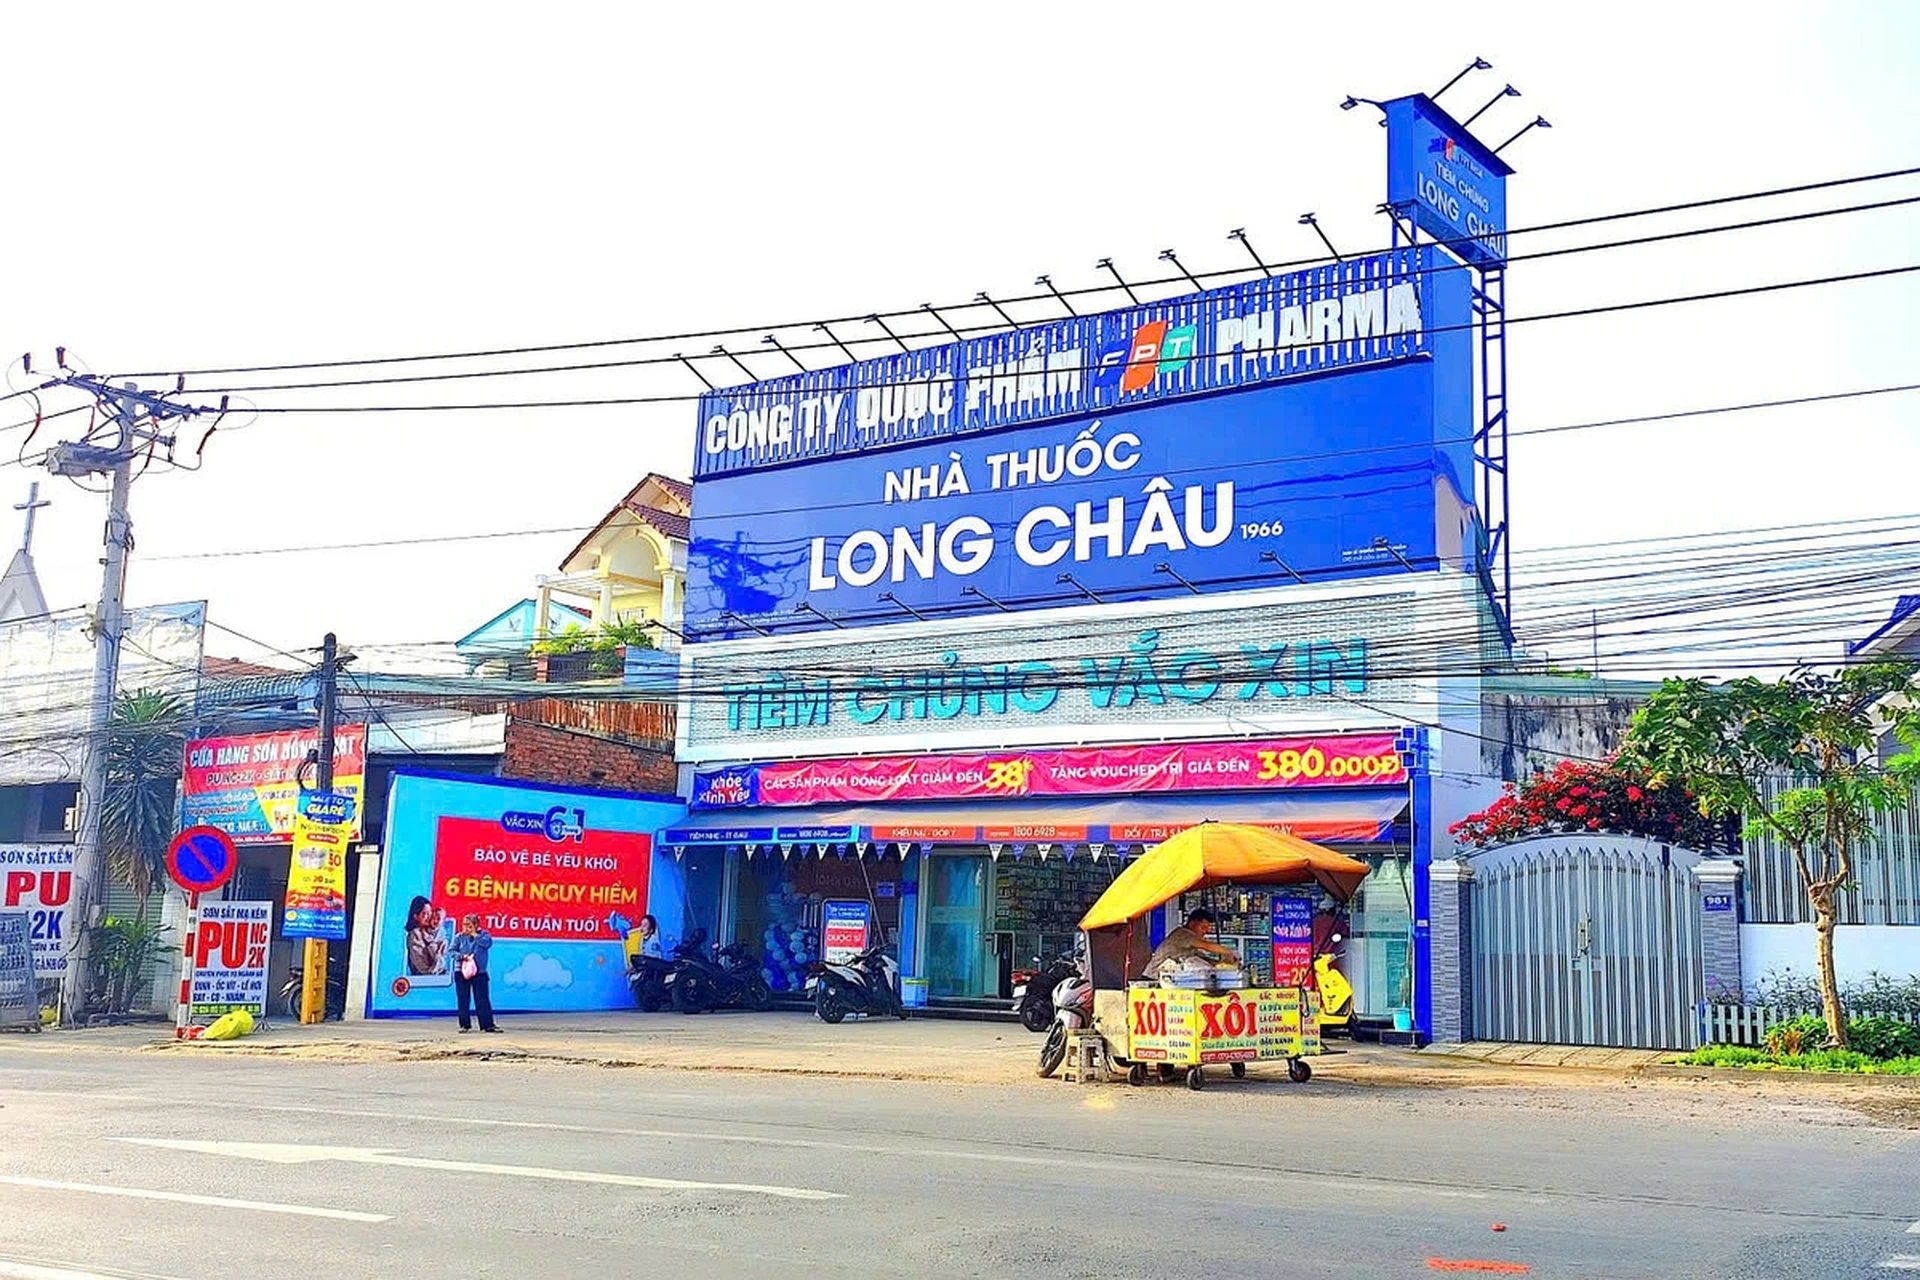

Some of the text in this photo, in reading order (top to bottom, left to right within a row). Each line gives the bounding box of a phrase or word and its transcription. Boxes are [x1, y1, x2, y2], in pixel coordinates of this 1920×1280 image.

[1418, 172, 1459, 222] LONG
[706, 403, 791, 458] CÔNG
[800, 392, 844, 442] TY
[966, 336, 1083, 415] PHẨM
[1097, 334, 1191, 378] FPT
[1216, 281, 1421, 365] PHARMA
[883, 420, 1141, 505] NHÀ THUỐC
[808, 477, 1284, 592] LONG CHÂU 1966
[724, 630, 1367, 731] TIÊM CHỦNG VẮC XIN
[217, 743, 250, 766] HÀNG
[921, 769, 952, 784] GIẢM
[956, 770, 983, 784] ĐẾN
[1090, 763, 1158, 779] VOUCHER
[1187, 758, 1214, 774] GIÁ
[1217, 756, 1250, 773] ĐẾN
[729, 788, 750, 802] Yêu
[527, 818, 544, 829] XIN
[1013, 826, 1032, 836] 1800
[1033, 825, 1056, 836] 6928
[0, 849, 24, 863] SƠN
[474, 844, 618, 870] BẢO VỆ BÉ YÊU KHỎI
[5, 871, 72, 907] PU
[446, 875, 637, 905] 6 BỆNH NGUY HIỂM
[31, 910, 64, 939] 2K
[485, 911, 600, 932] TỪ 6 TUẦN TUỔI
[196, 921, 268, 969] PU NC
[247, 946, 265, 968] 2K
[1133, 991, 1168, 1036] XÔI
[1201, 991, 1258, 1038] XÔI
